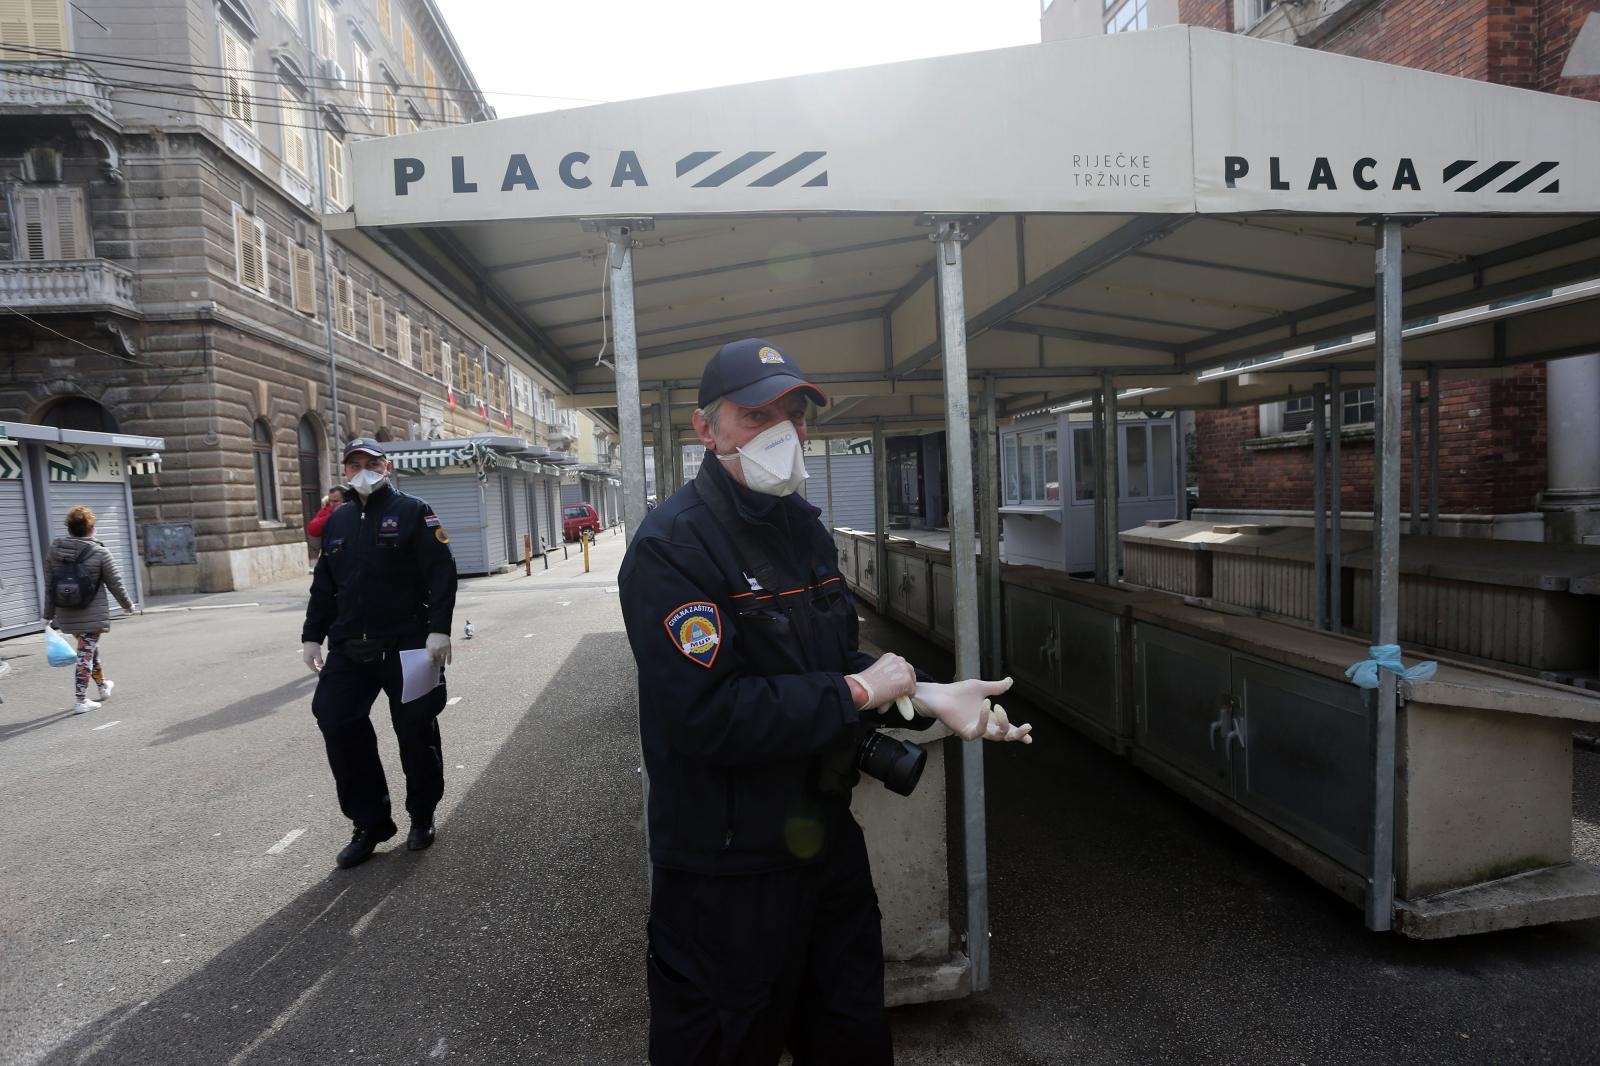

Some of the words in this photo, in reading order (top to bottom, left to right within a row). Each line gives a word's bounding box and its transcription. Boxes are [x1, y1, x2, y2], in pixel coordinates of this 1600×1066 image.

[1073, 152, 1151, 169] RIJEČKE
[393, 150, 649, 196] PLACA
[1072, 171, 1151, 188] TRŽNICE
[1224, 156, 1422, 191] PLACA
[668, 608, 689, 627] CIVILNA
[689, 604, 714, 614] ZAŠTITA
